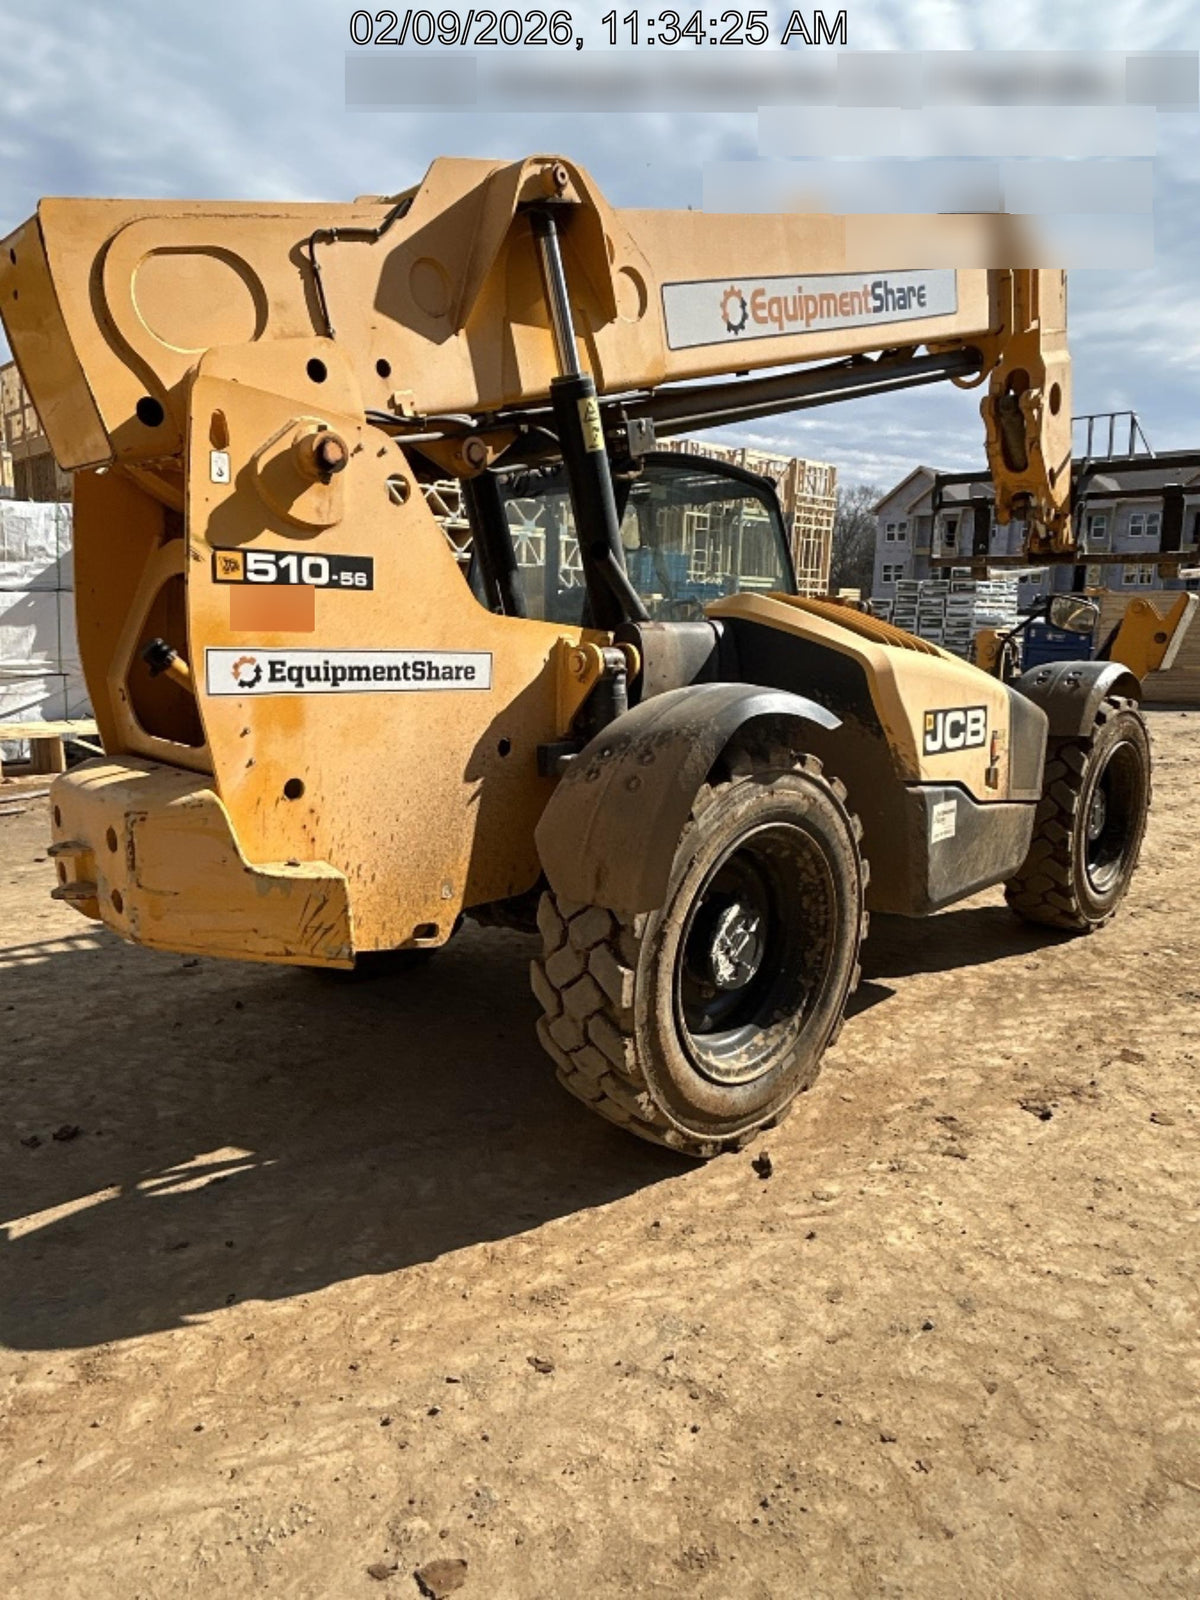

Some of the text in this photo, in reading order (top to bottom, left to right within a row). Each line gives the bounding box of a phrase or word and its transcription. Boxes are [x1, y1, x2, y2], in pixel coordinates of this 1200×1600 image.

[751, 280, 927, 331] EquipmentShare
[267, 660, 476, 688] EquipmentShare
[925, 709, 986, 752] JCB
